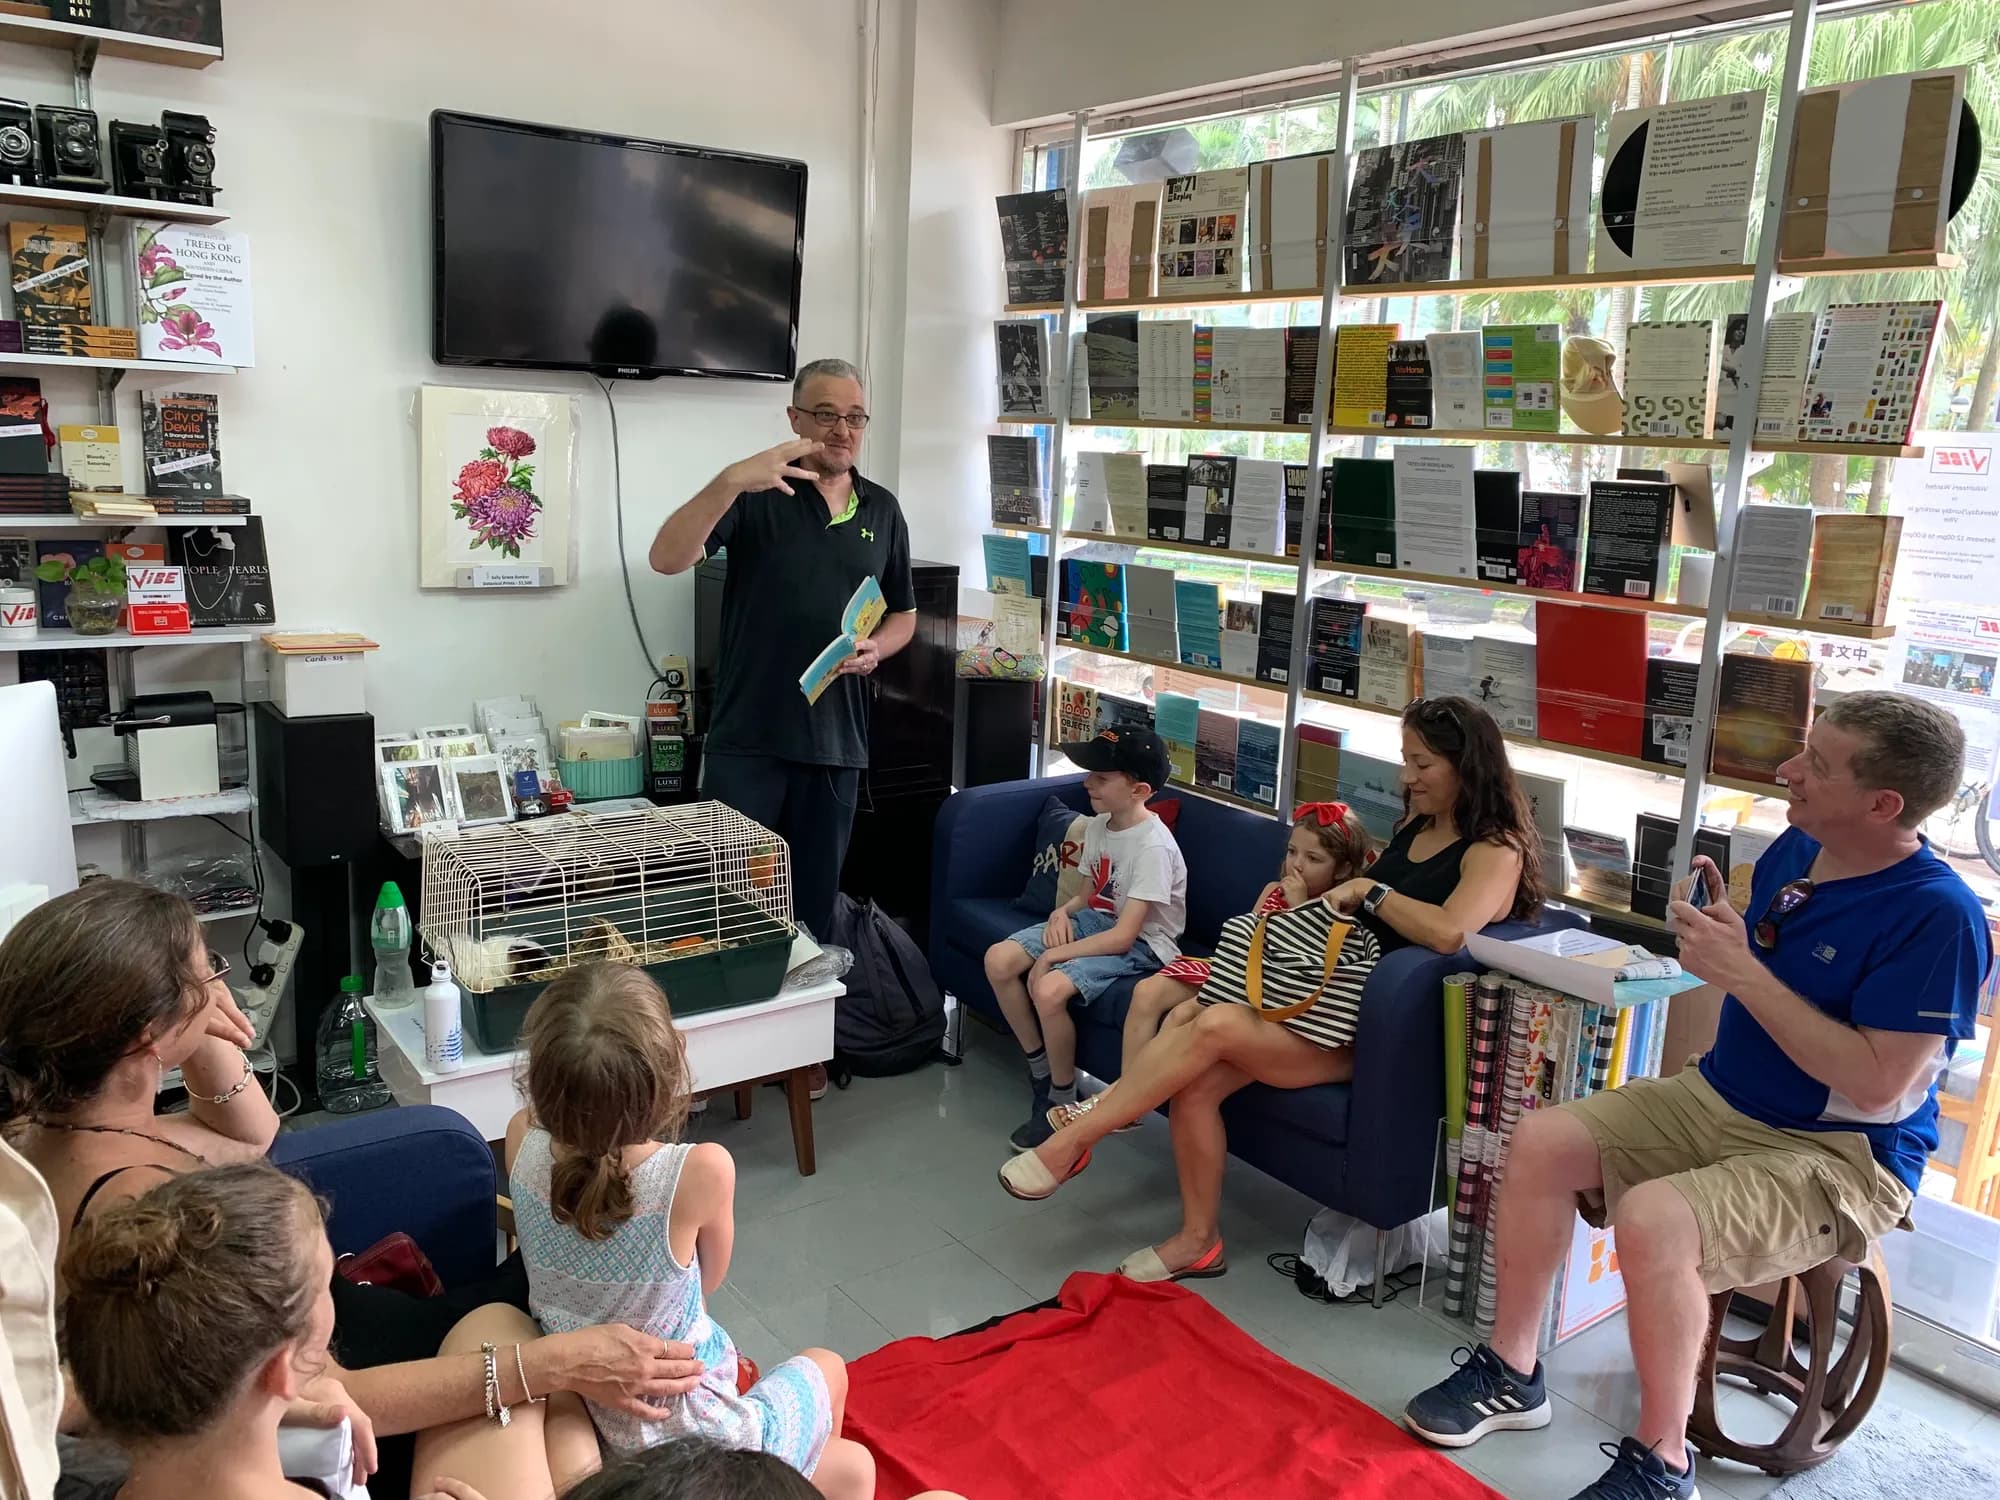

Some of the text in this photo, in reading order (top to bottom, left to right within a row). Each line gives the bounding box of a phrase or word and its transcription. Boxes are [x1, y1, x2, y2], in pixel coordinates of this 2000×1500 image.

[70, 6, 92, 18] RAY
[184, 239, 233, 252] TREES OF
[176, 248, 241, 264] HONG KONG
[186, 272, 203, 280] Signed
[164, 410, 204, 424] City of
[164, 421, 201, 433] Devils
[165, 440, 208, 449] Paul French
[184, 566, 218, 575] EOPLE
[229, 566, 268, 575] PEARLS
[1062, 703, 1091, 719] 1000
[1062, 719, 1091, 732] OBJECTS
